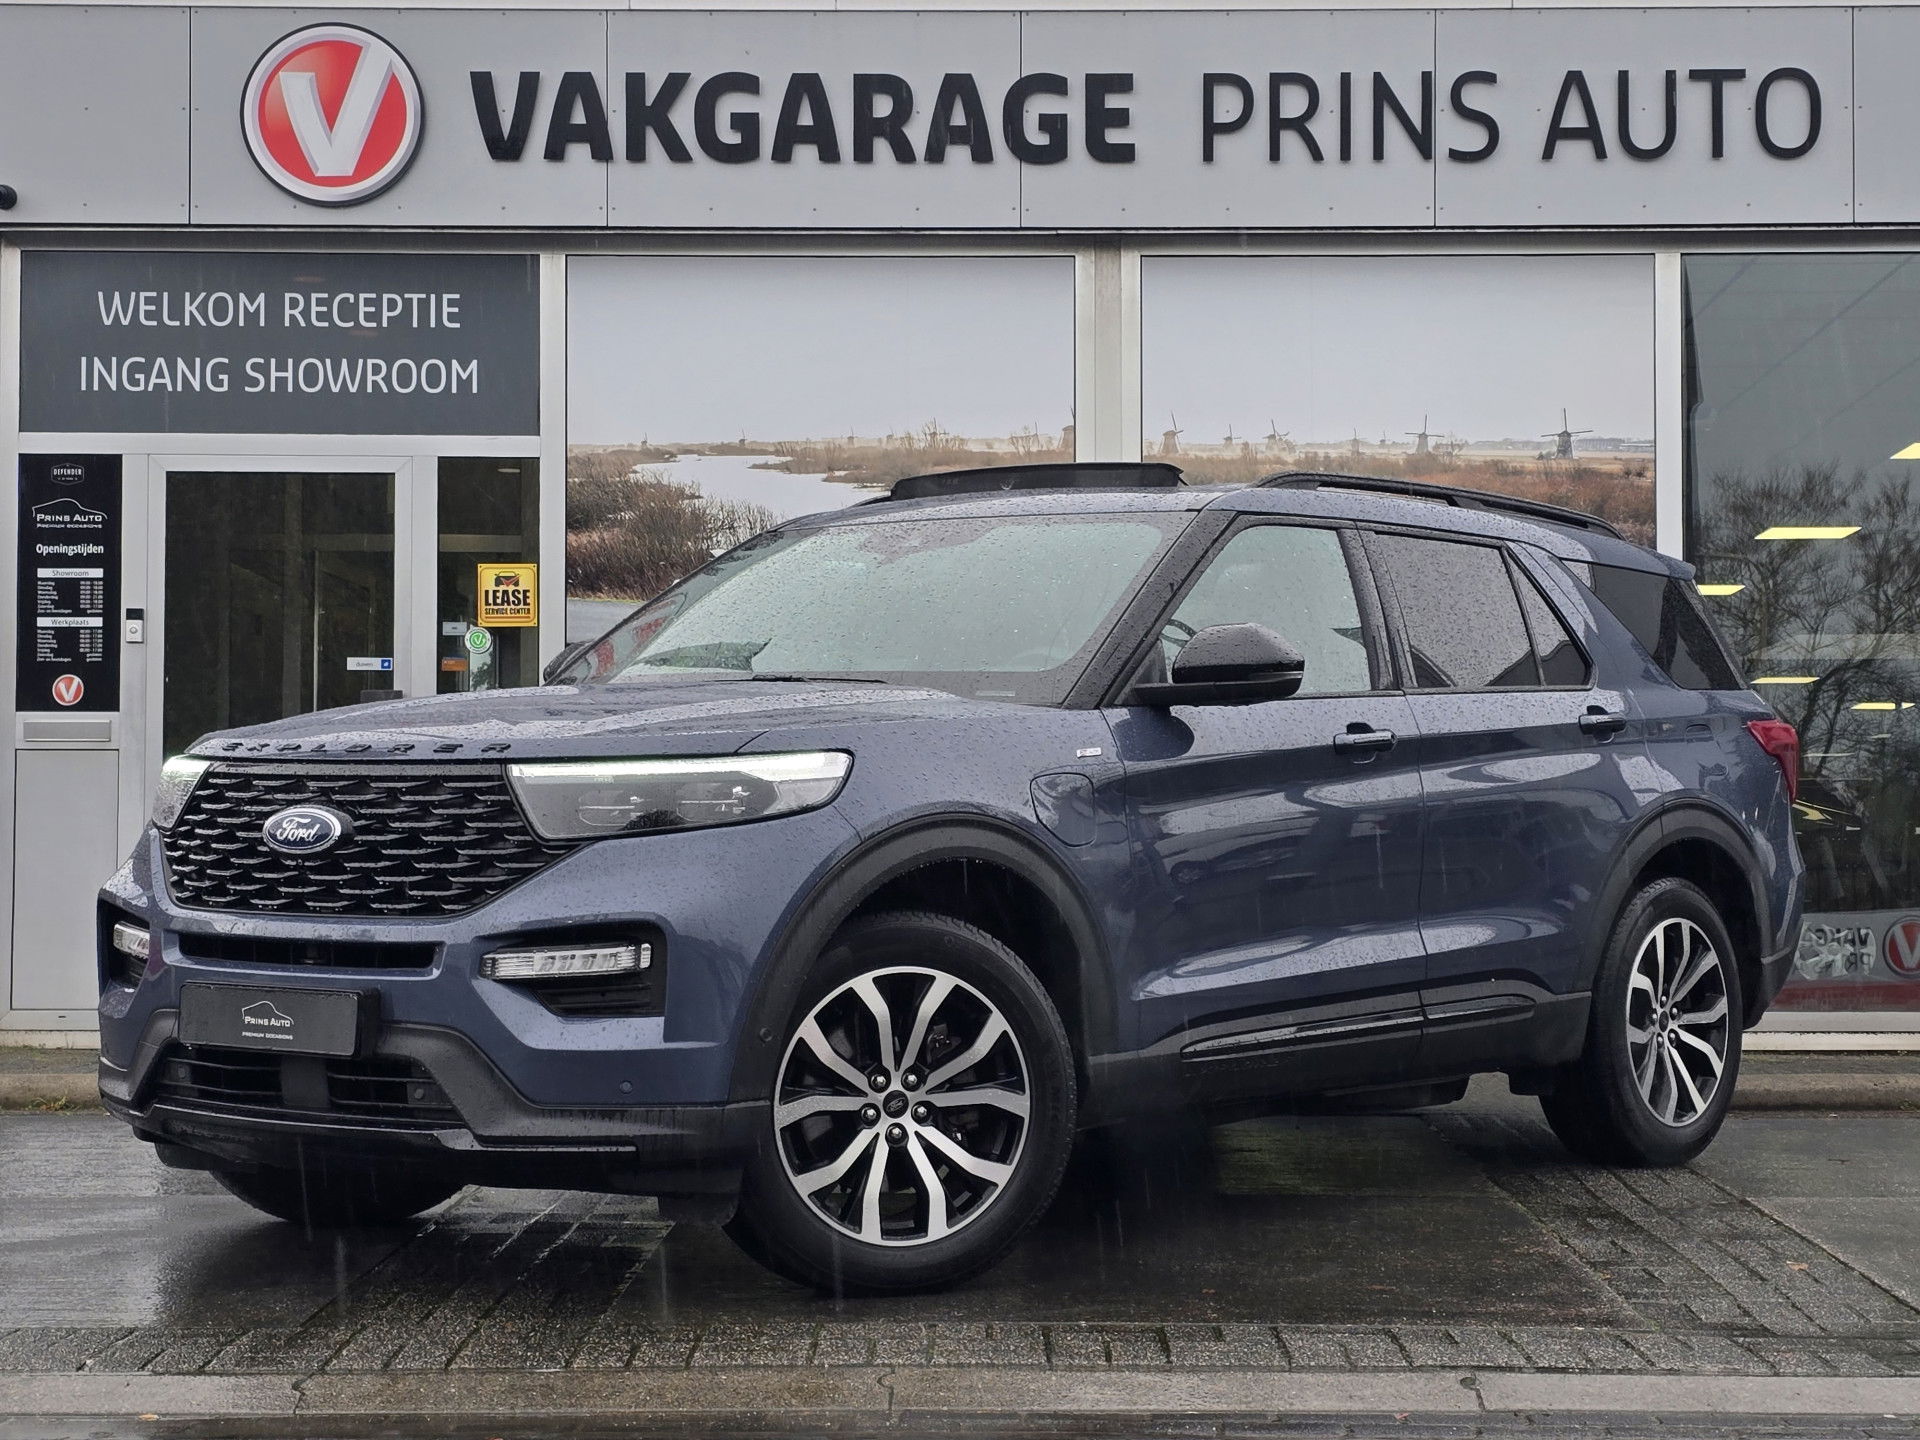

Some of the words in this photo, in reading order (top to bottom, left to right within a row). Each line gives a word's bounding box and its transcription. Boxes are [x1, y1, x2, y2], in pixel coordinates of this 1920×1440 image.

[470, 71, 1136, 165] VAKGARAGE
[1203, 70, 1500, 162] PRINS
[1542, 67, 1822, 160] AUTO
[98, 291, 266, 327] WELKOM
[284, 293, 462, 329] RECEPTIE
[80, 356, 229, 393] INGANG
[245, 358, 479, 394] SHOWROOM
[53, 468, 82, 476] DEFENDER
[36, 543, 104, 557] Openingstijden
[52, 569, 89, 577] Showroom
[484, 589, 531, 607] LEASE
[484, 607, 508, 615] SERVICE
[509, 607, 531, 615] CENTER
[51, 619, 89, 627] Werkplaats
[221, 742, 512, 754] EXPLORER
[275, 817, 320, 843] Ford
